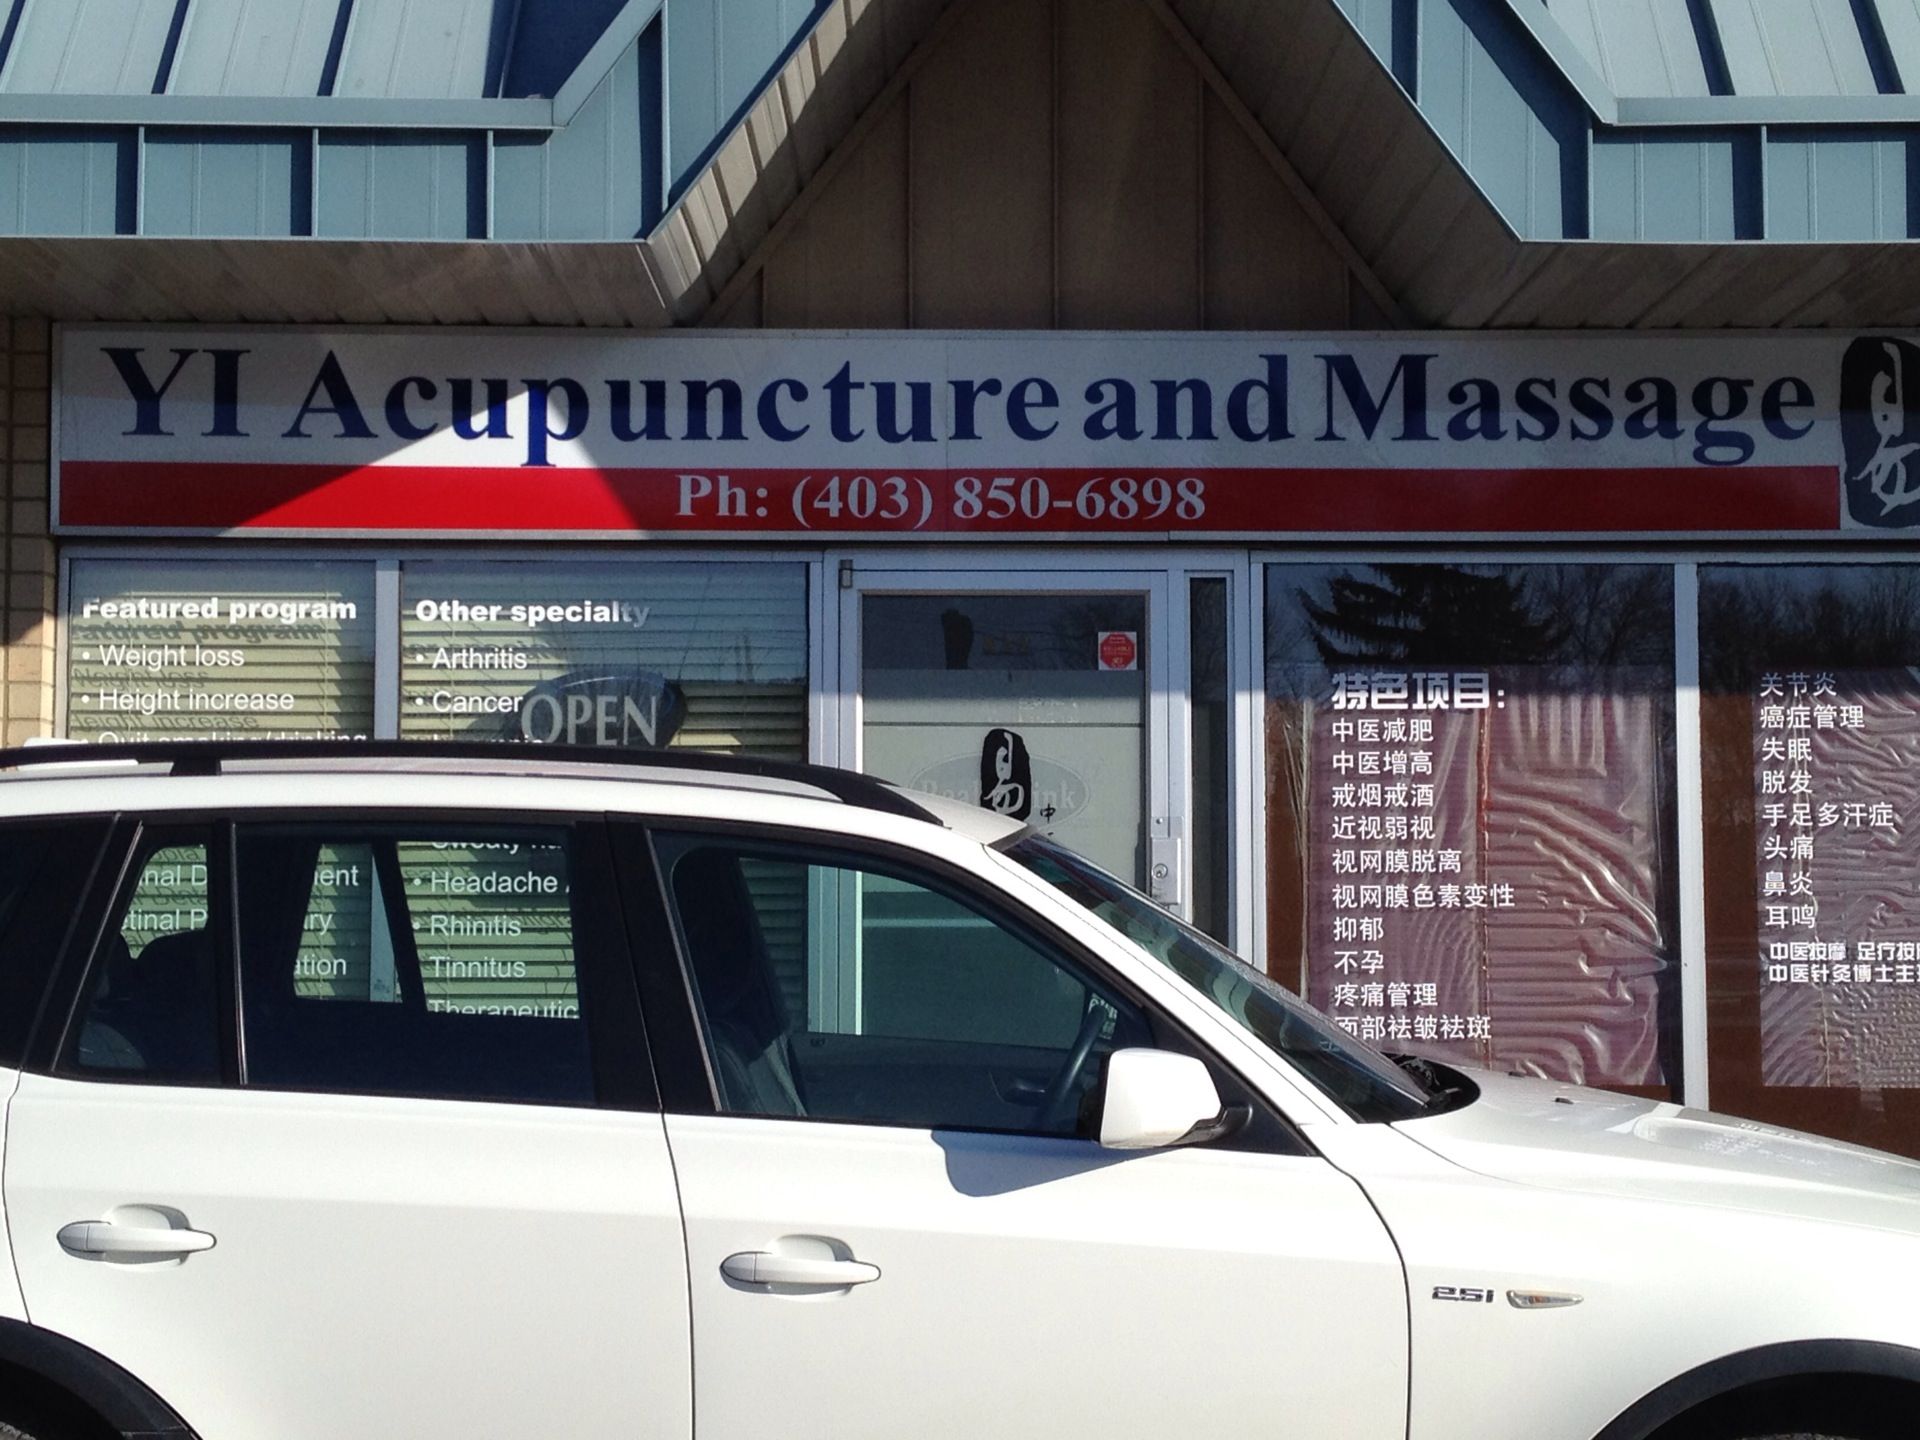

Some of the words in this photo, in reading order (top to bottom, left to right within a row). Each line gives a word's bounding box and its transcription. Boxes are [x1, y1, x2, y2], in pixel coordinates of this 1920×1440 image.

[101, 347, 251, 437] YI
[281, 350, 1060, 467] Acupuncture
[1082, 354, 1295, 443] and
[1314, 354, 1815, 466] Massage
[675, 475, 768, 518] Ph:
[792, 476, 933, 529] (403)
[953, 477, 1206, 520] 850-6898
[83, 598, 218, 619] Featured
[230, 601, 356, 624] program
[416, 600, 502, 622] Other
[511, 600, 649, 627] specialty
[99, 645, 187, 671] Weight
[195, 645, 244, 666] loss
[433, 648, 527, 669] Arthritis
[1760, 672, 1837, 697] 关节炎
[99, 689, 181, 714] Height
[189, 690, 294, 710] increase
[433, 691, 523, 713] Cancer
[521, 694, 657, 746] OPEN
[1760, 704, 1865, 729] 癌症管理
[1332, 717, 1434, 743] 中医减肥
[1762, 737, 1813, 761] 失眠
[1332, 750, 1433, 775] 中医增高
[1762, 770, 1813, 794] 脱发
[1332, 783, 1435, 807] 戒烟戒酒
[1762, 802, 1894, 827] 手足多汗症
[1332, 816, 1435, 840] 近视弱视
[1764, 835, 1814, 860] 头痛
[1332, 849, 1462, 874] 视网膜脱离
[431, 871, 558, 893] Headache
[1763, 870, 1813, 896] 鼻炎
[1332, 883, 1515, 908] 视网膜色素变性
[431, 915, 521, 936] Rhinitis
[1333, 916, 1384, 942] 抑郁
[1765, 904, 1815, 929] 耳鸣
[1334, 950, 1384, 975] 不孕
[1770, 942, 1846, 961] 中医按摩
[430, 956, 526, 977] Tinnitus
[1335, 982, 1438, 1007] 疼痛管理
